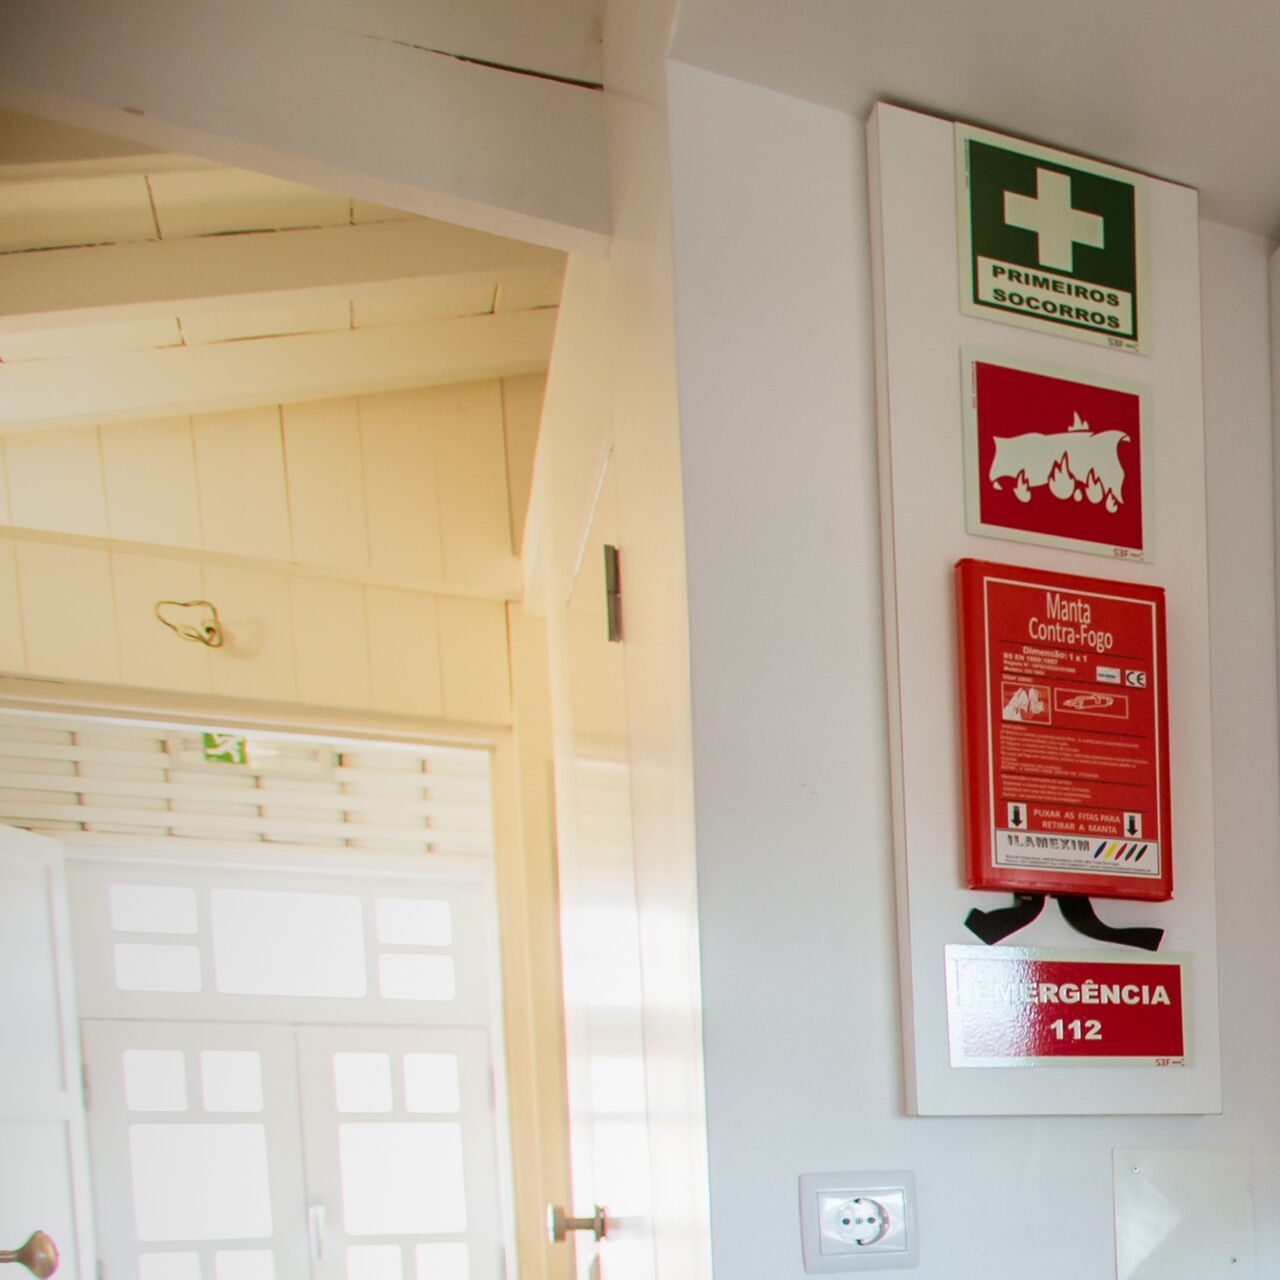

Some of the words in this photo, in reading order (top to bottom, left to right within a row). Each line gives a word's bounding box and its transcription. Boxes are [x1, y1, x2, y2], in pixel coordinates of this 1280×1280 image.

[992, 265, 1120, 307] PRIMEIROS
[992, 288, 1121, 329] SOCORROS
[1046, 591, 1091, 624] Manta
[1028, 617, 1113, 653] Contra-Fogo
[1069, 653, 1074, 661] 1
[1082, 655, 1088, 663] 1
[1033, 808, 1061, 818] PUXAR
[1064, 811, 1075, 820] AS
[1078, 812, 1100, 822] FITAS
[1100, 814, 1121, 824] PARA
[1042, 821, 1075, 831] RETIRAR
[1079, 824, 1085, 832] A
[1088, 824, 1118, 834] MANTA
[1006, 834, 1091, 852] ILAMEXIM
[1049, 1018, 1103, 1040] 112
